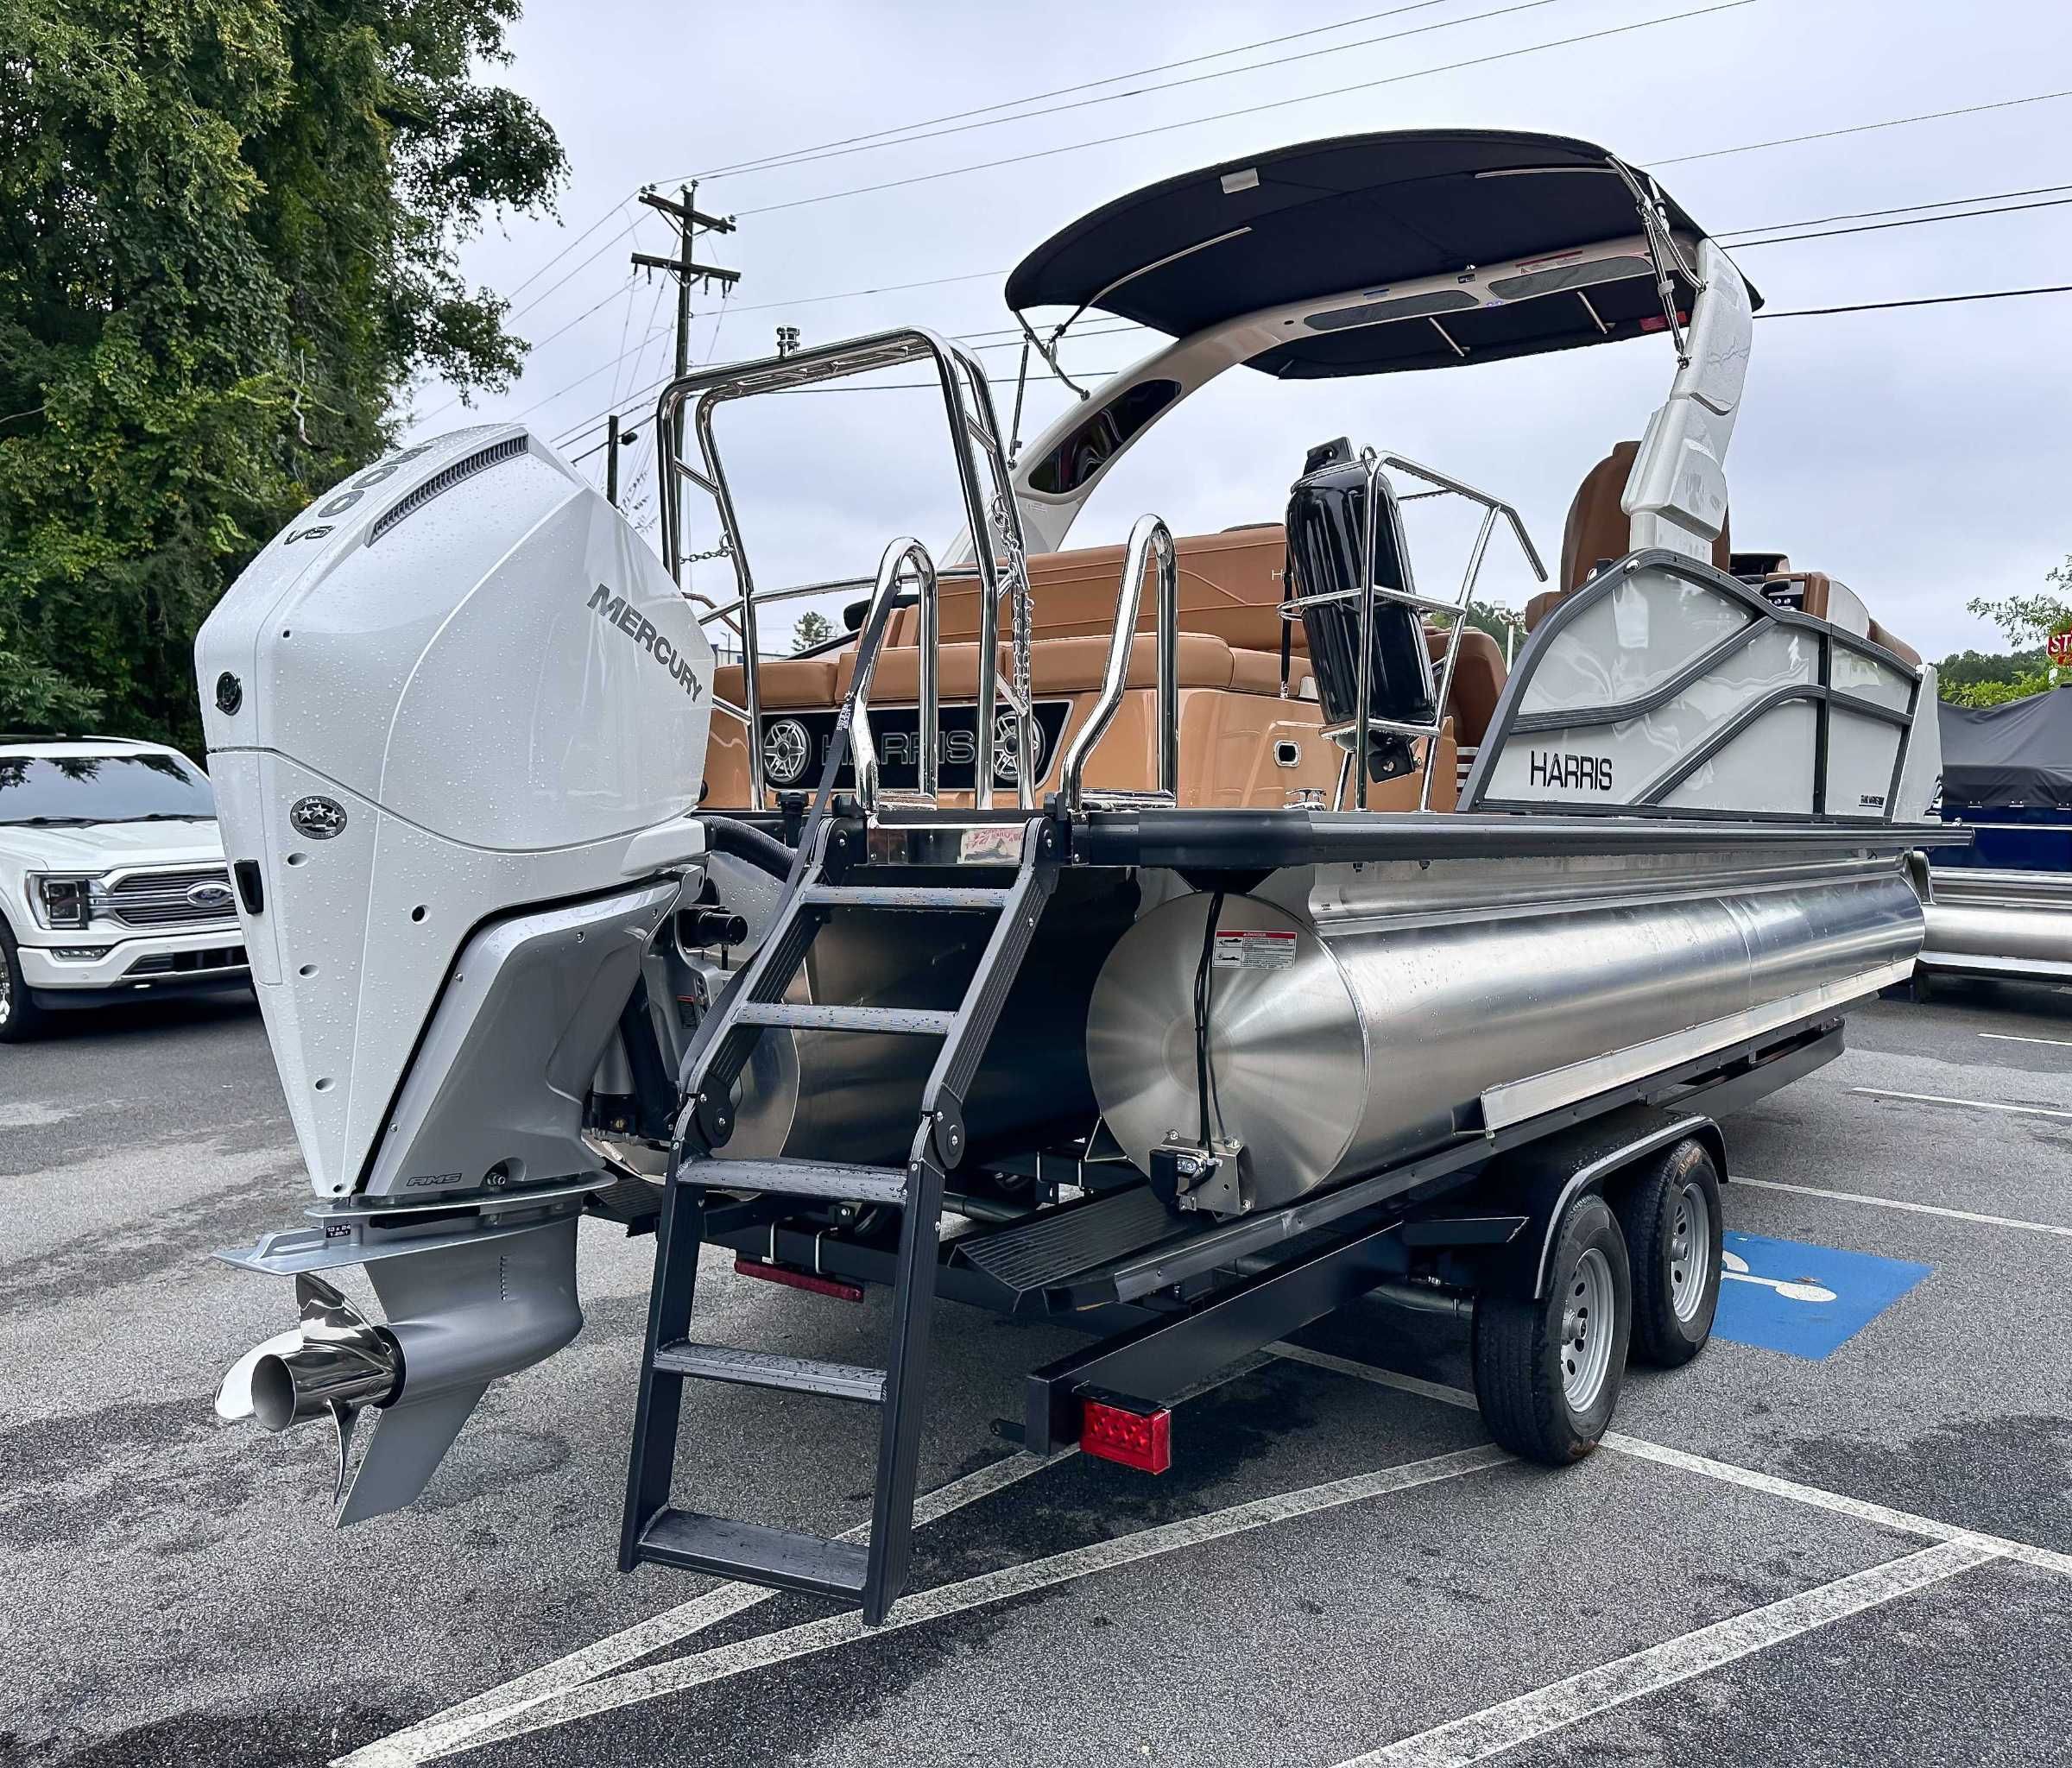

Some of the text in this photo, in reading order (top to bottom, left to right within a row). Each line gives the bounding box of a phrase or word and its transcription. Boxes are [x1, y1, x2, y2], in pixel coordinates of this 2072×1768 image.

[587, 583, 703, 703] MERCURY
[822, 731, 975, 765] HRIS
[1530, 749, 1613, 791] HARRIS
